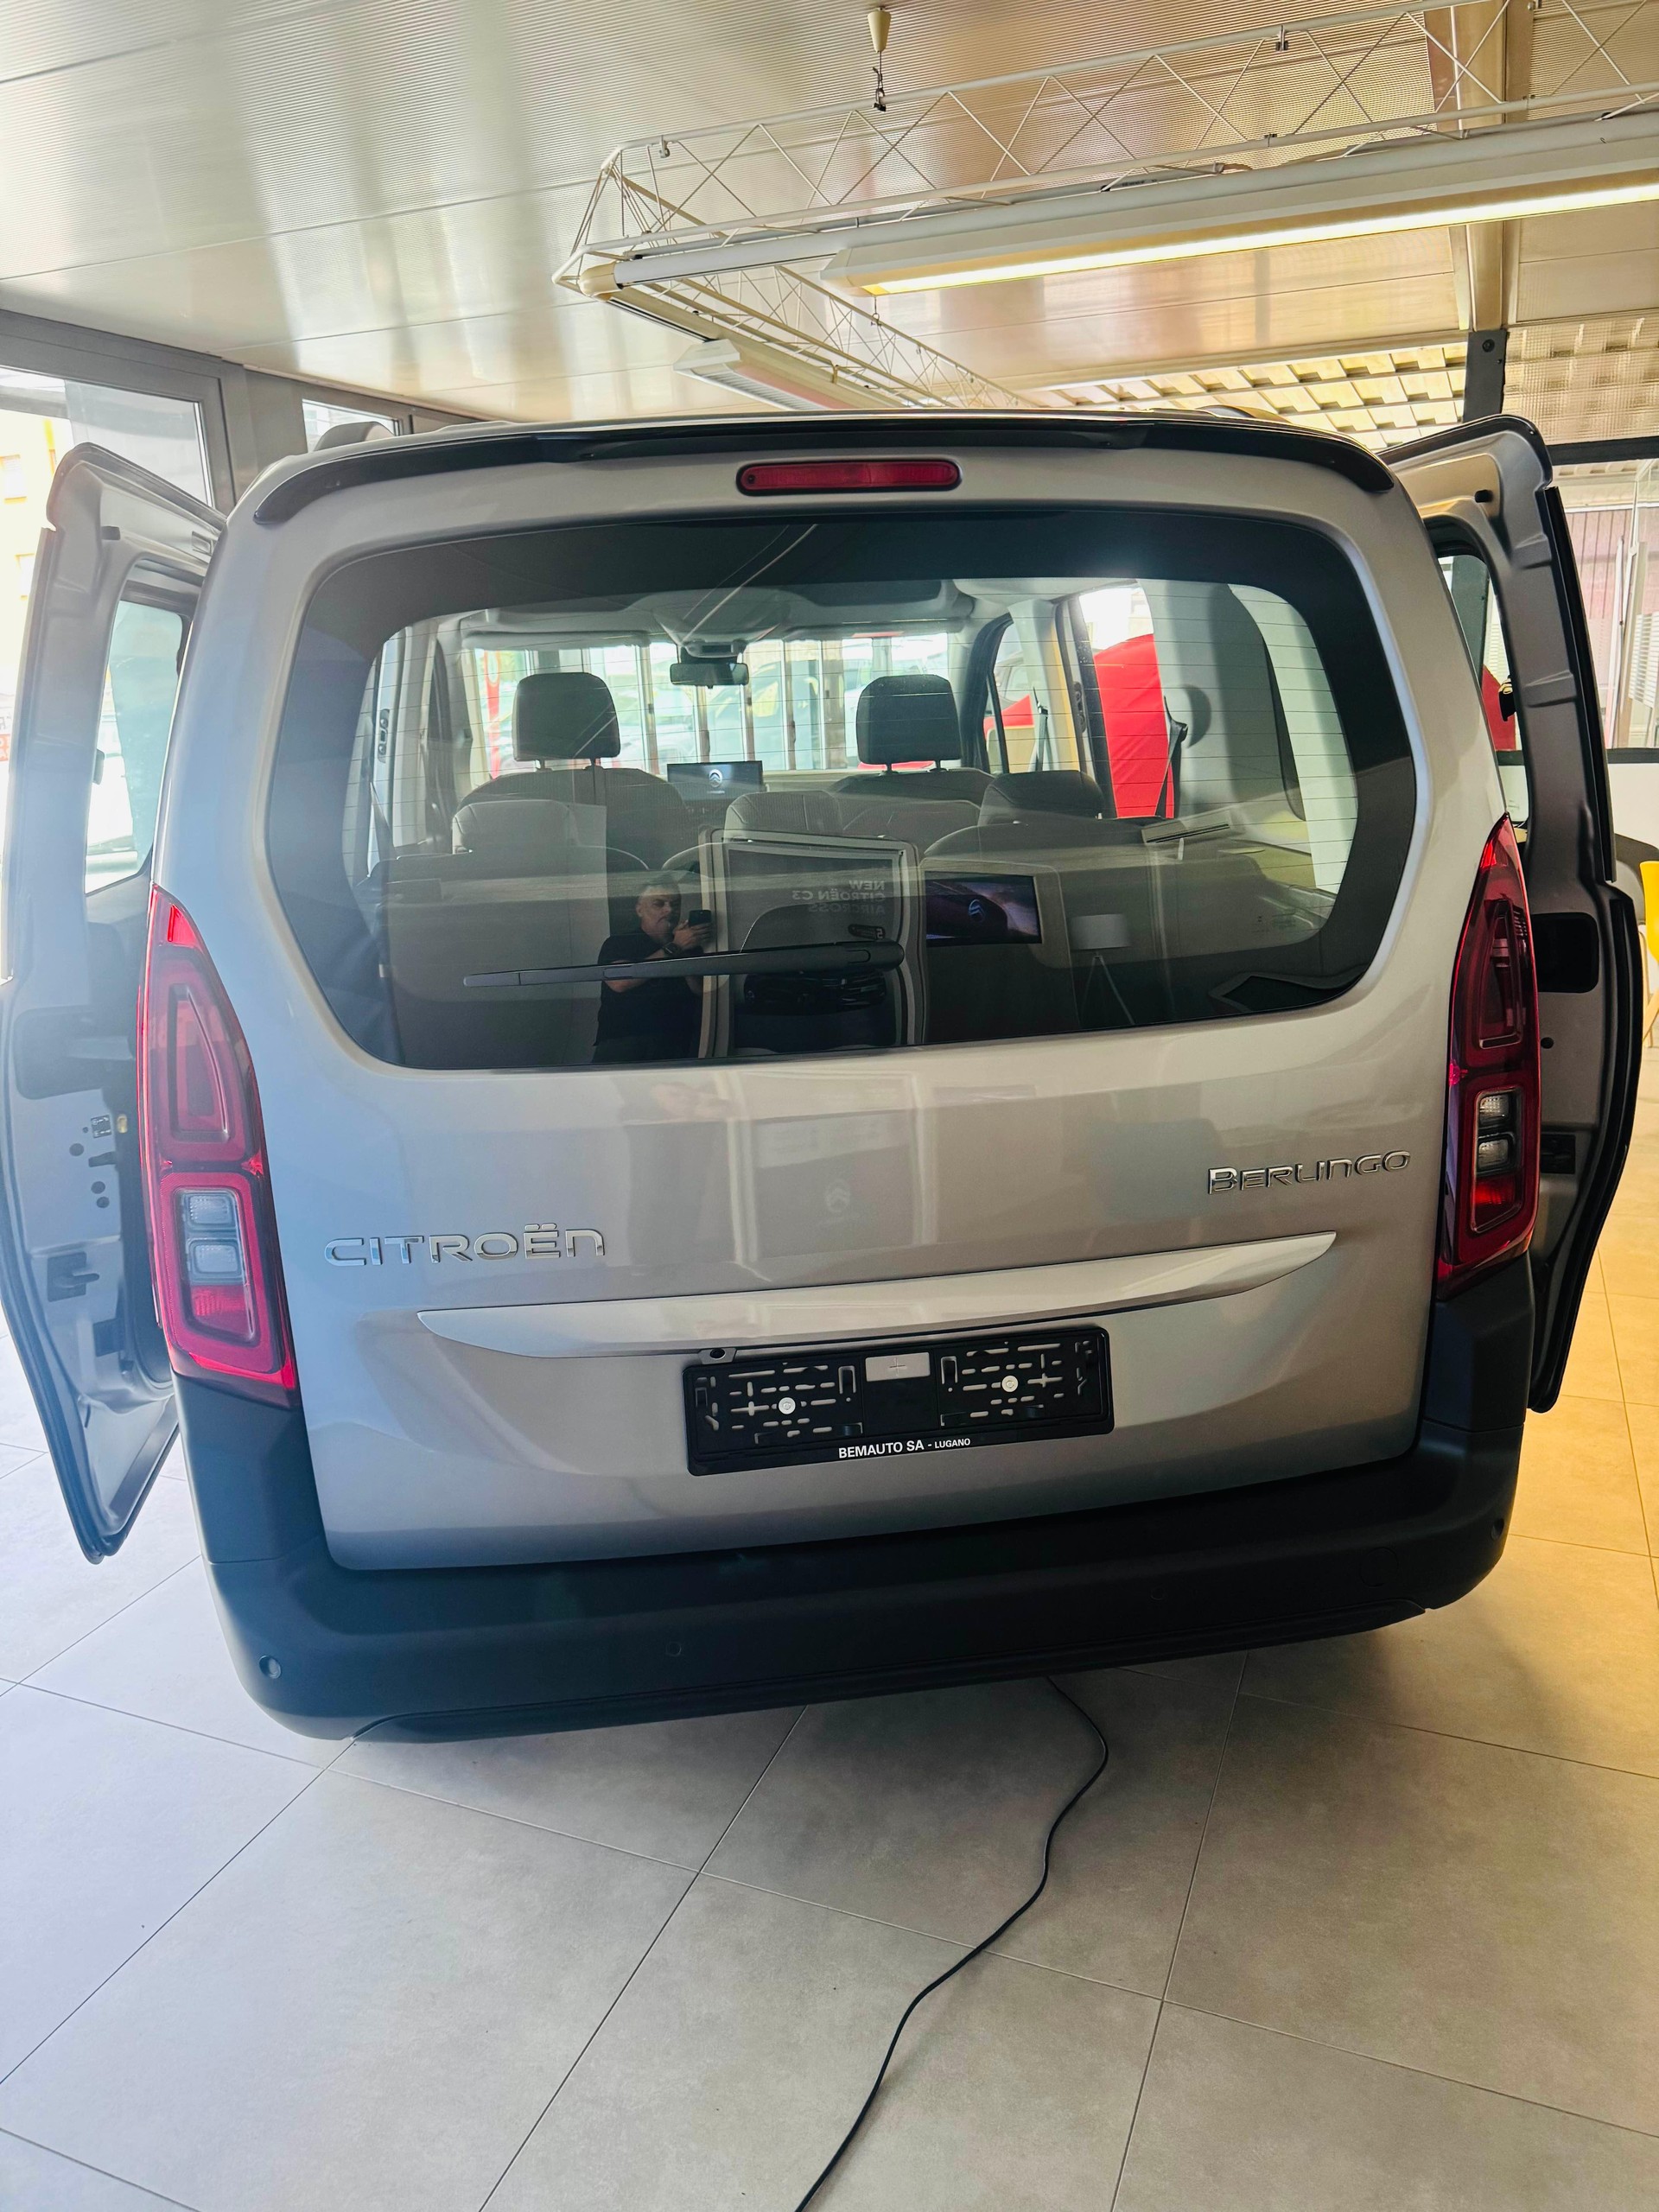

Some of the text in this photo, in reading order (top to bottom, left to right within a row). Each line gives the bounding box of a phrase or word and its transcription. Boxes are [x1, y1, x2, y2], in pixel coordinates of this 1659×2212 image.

[1208, 1150, 1411, 1194] BERLINGO
[324, 1223, 605, 1267] CITROËN
[838, 1441, 903, 1459] BEMAUTO
[906, 1440, 925, 1452] SA
[934, 1438, 971, 1449] LUGANO
